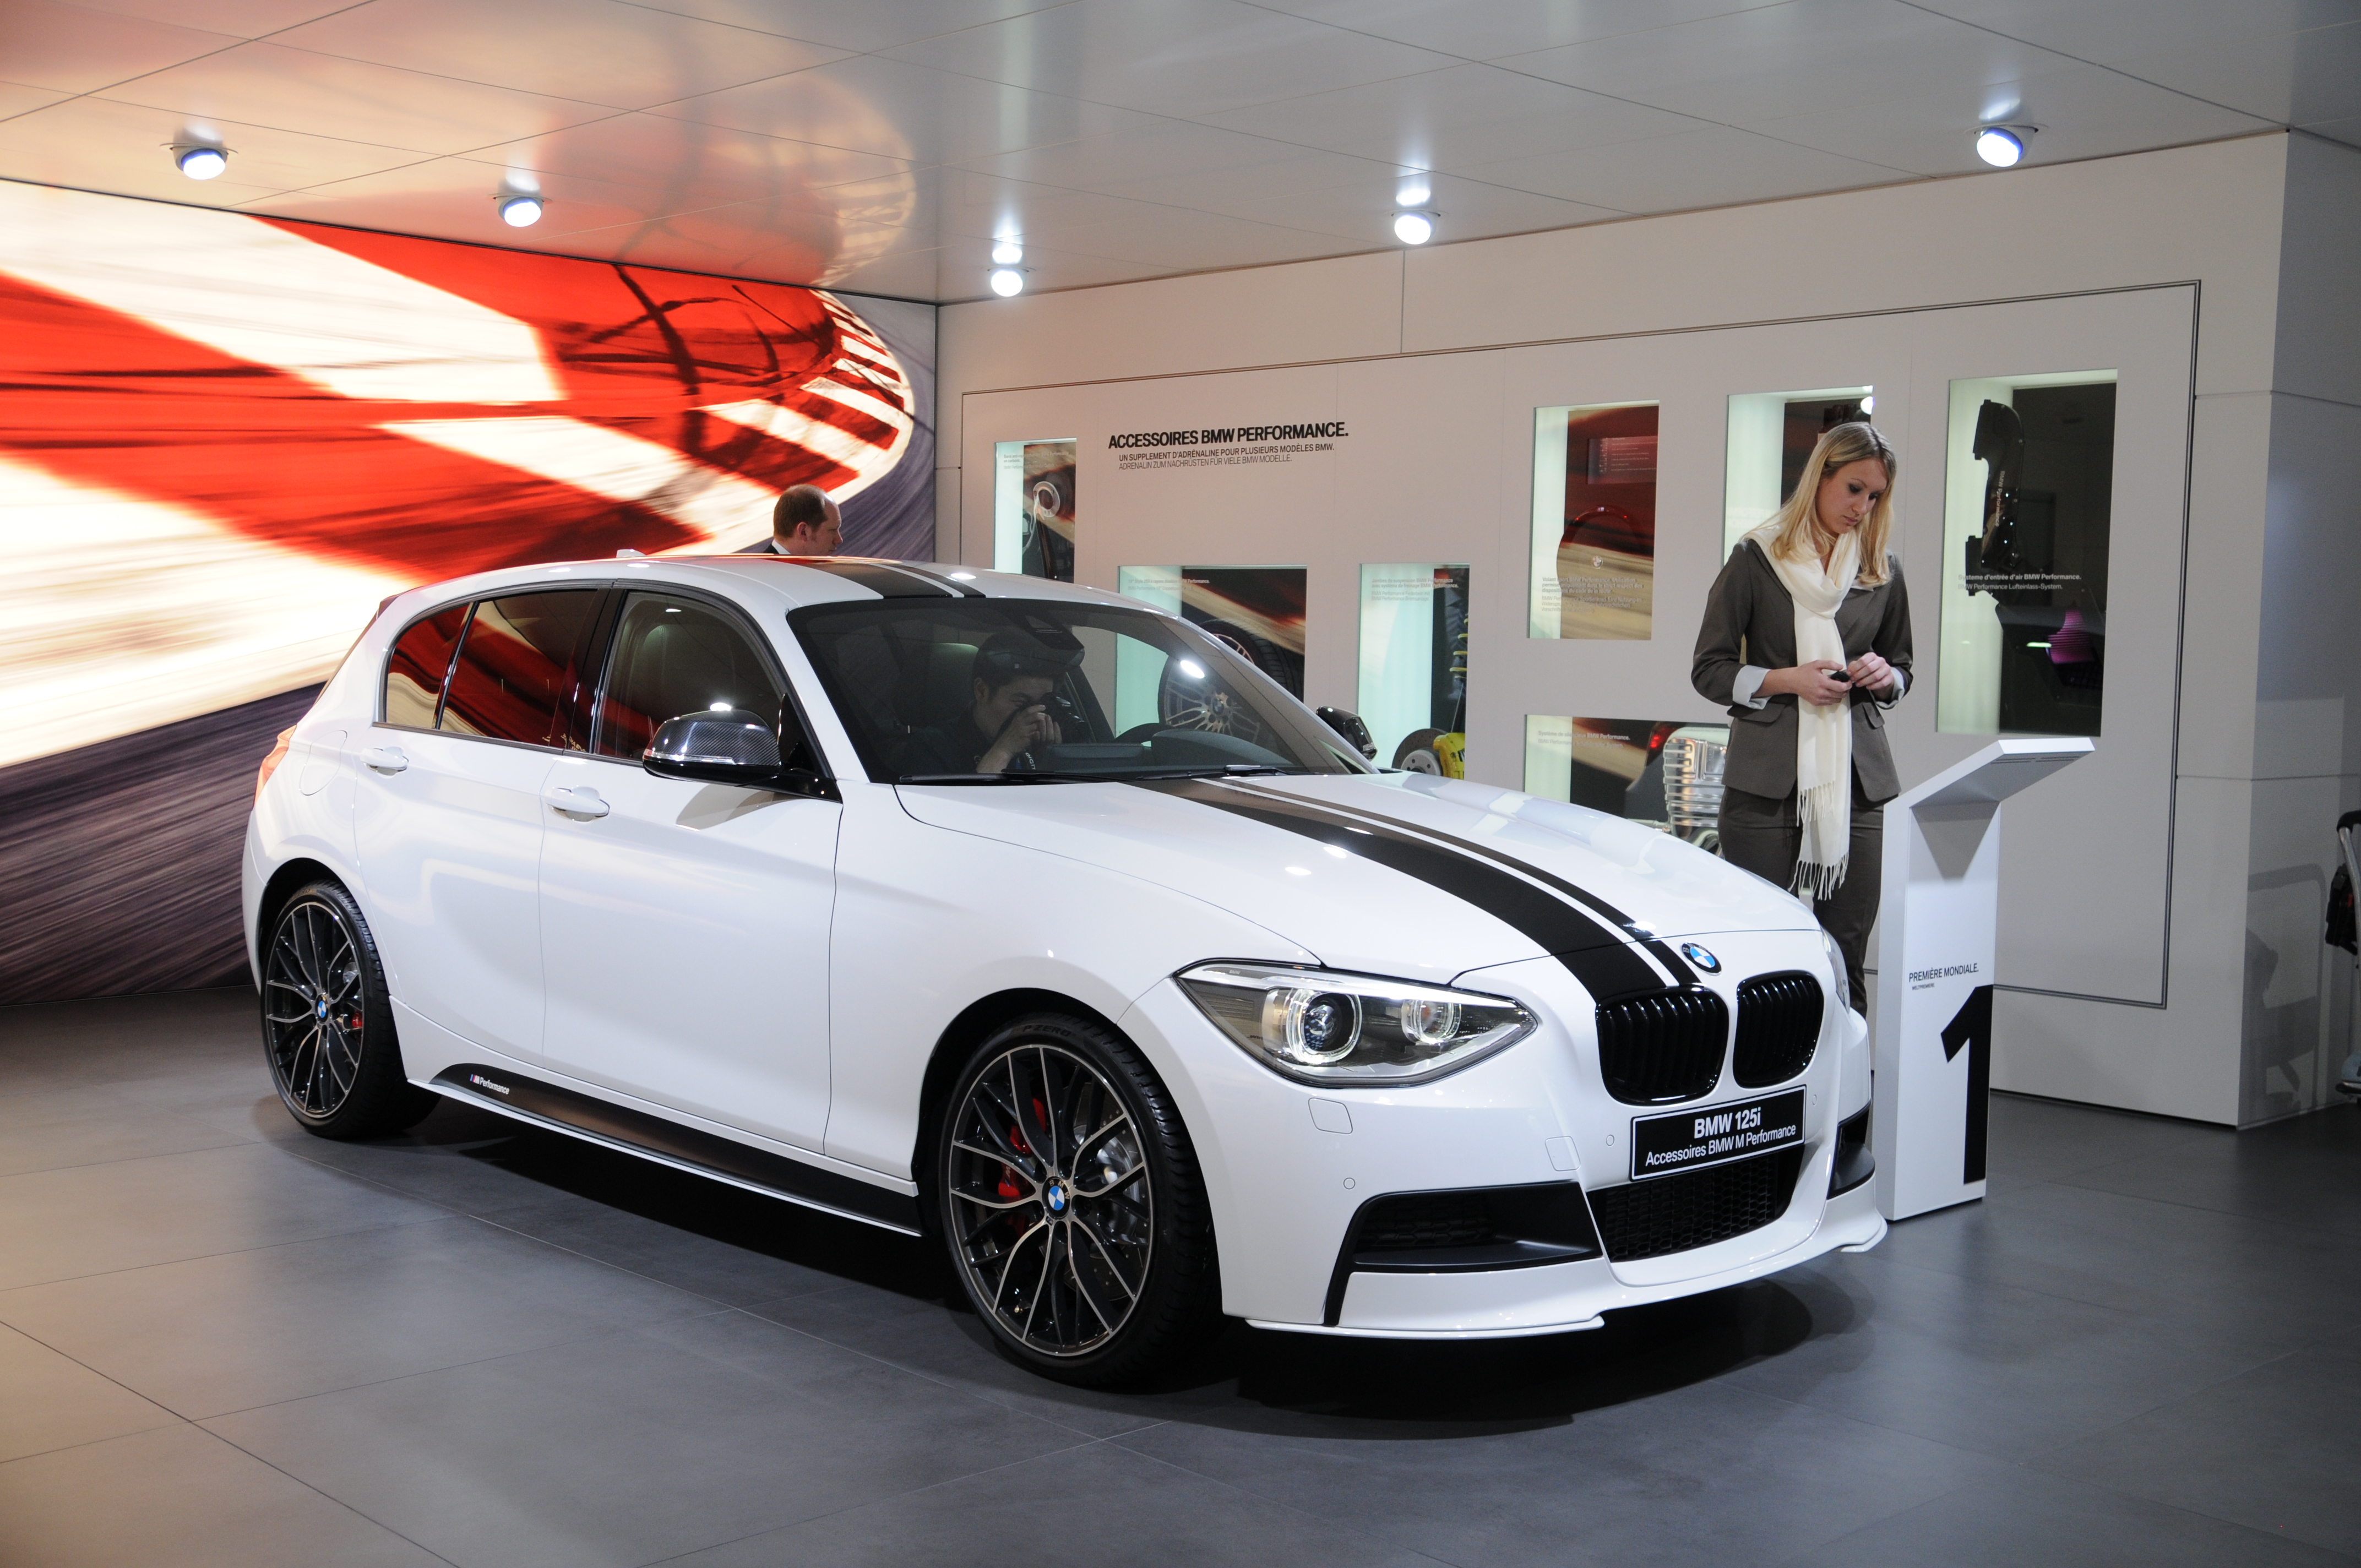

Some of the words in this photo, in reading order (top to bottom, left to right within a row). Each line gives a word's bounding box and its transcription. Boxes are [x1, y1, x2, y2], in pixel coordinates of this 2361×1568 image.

[1108, 431, 1198, 449] ACCESSOIRES
[1201, 428, 1234, 444] BMW
[1237, 422, 1348, 442] PERFORMANCE.
[1119, 461, 1152, 470] ADRENALIN
[1153, 460, 1166, 469] ZUM
[1167, 458, 1209, 467] NACHRÜSTEN
[1210, 456, 1223, 466] FÜR
[1224, 456, 1241, 465] VIELE
[1242, 455, 1258, 464] BMW
[1259, 454, 1292, 463] MODELLE.
[1129, 452, 1172, 461] SUPPLEMENT
[1172, 449, 1220, 459] D'ADRÉNALINE
[1221, 447, 1239, 456] POUR
[1241, 445, 1279, 455] PLUSIEURS
[1280, 443, 1314, 454] MODÈLES
[1315, 443, 1335, 451] BMW.
[1909, 967, 1943, 982] PREMIÈRE
[1944, 963, 1979, 977] MONDIALE.
[1033, 1025, 1071, 1036] ZERO
[480, 1077, 510, 1095] Performance
[1940, 984, 1993, 1185] 1
[1694, 1113, 1733, 1139] BMW
[1735, 1107, 1761, 1130] 125i
[1645, 1144, 1706, 1167] Accessoires
[1708, 1136, 1734, 1155] BMW
[1736, 1134, 1744, 1148] M
[1746, 1124, 1796, 1146] Performance
[1049, 1179, 1070, 1200] BMW
